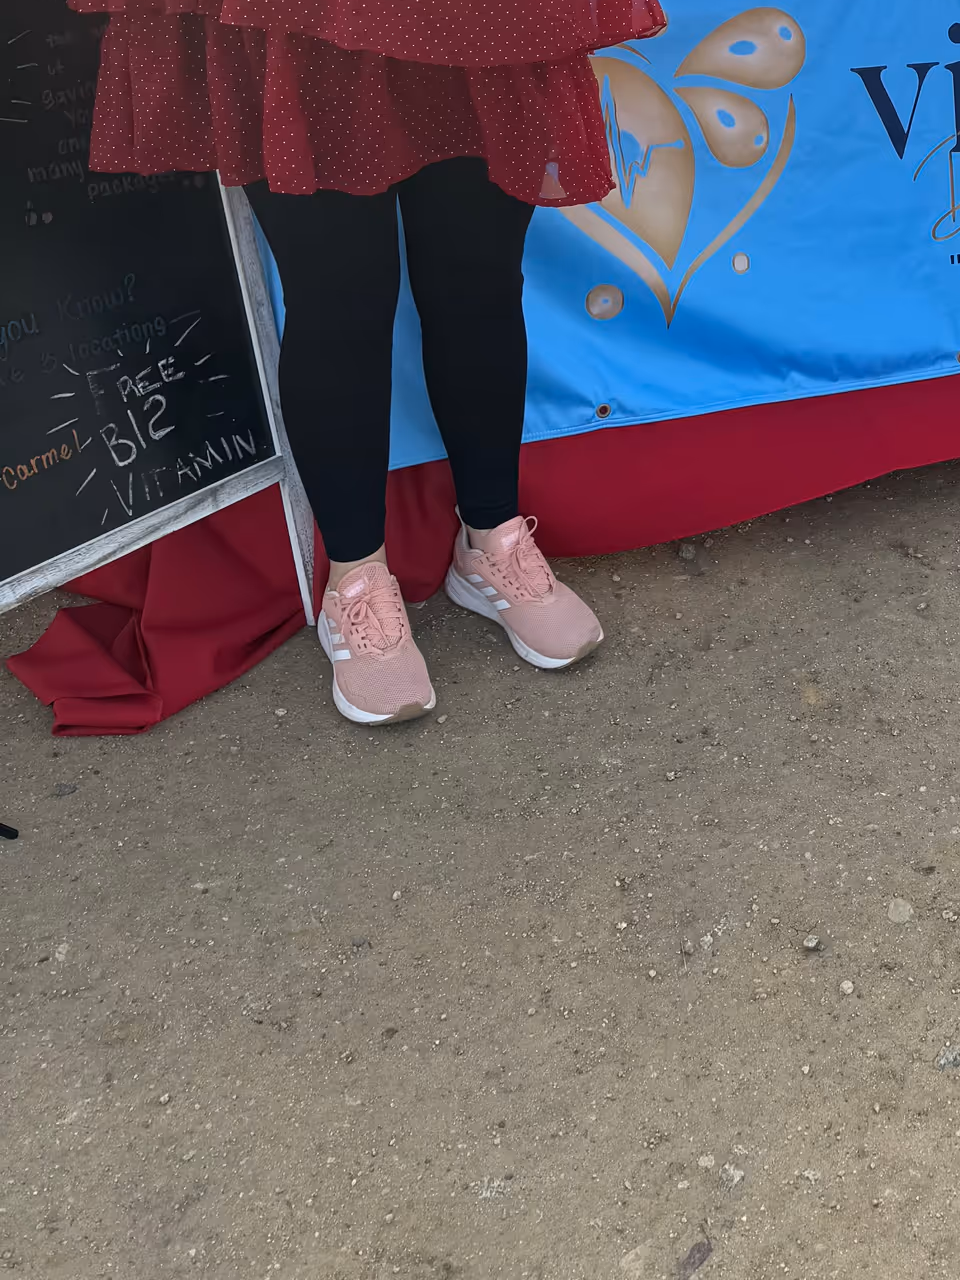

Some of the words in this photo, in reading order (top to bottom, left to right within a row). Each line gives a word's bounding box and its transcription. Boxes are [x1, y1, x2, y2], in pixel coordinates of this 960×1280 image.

[86, 356, 186, 415] FREE
[99, 394, 176, 467] B12
[111, 429, 258, 516] VITAMIN
